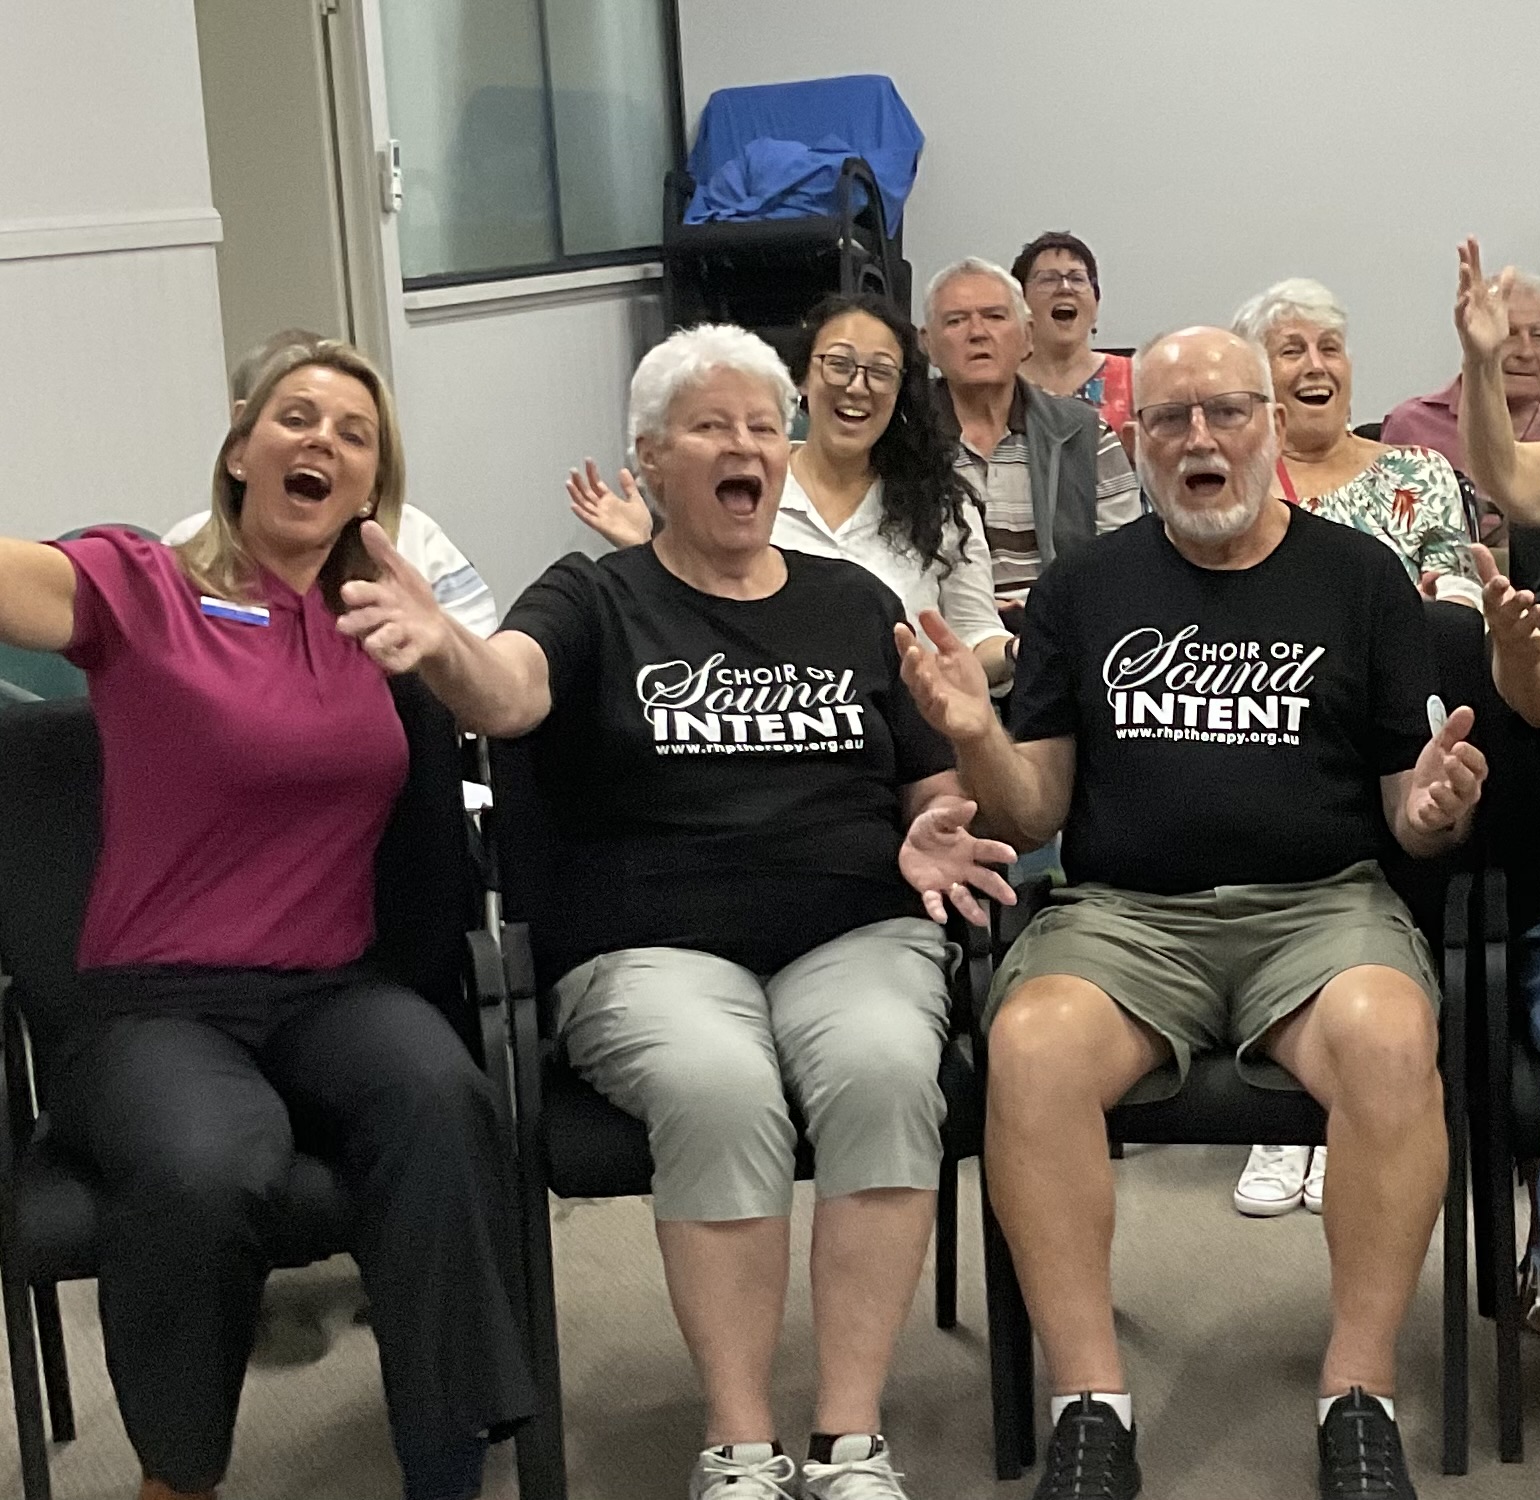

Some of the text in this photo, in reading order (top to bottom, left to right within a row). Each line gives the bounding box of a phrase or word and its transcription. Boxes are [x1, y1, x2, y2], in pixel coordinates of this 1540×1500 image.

[1102, 624, 1326, 709] Sound
[1184, 642, 1304, 661] CHOIR OF
[636, 652, 856, 725] Sound
[717, 663, 836, 685] CHOIR OF
[653, 704, 864, 742] INTENT
[1115, 691, 1310, 731] INTENT
[655, 739, 864, 755] www.rhptherapy.org.au
[1116, 726, 1300, 745] www.rhptherapy.org.au
